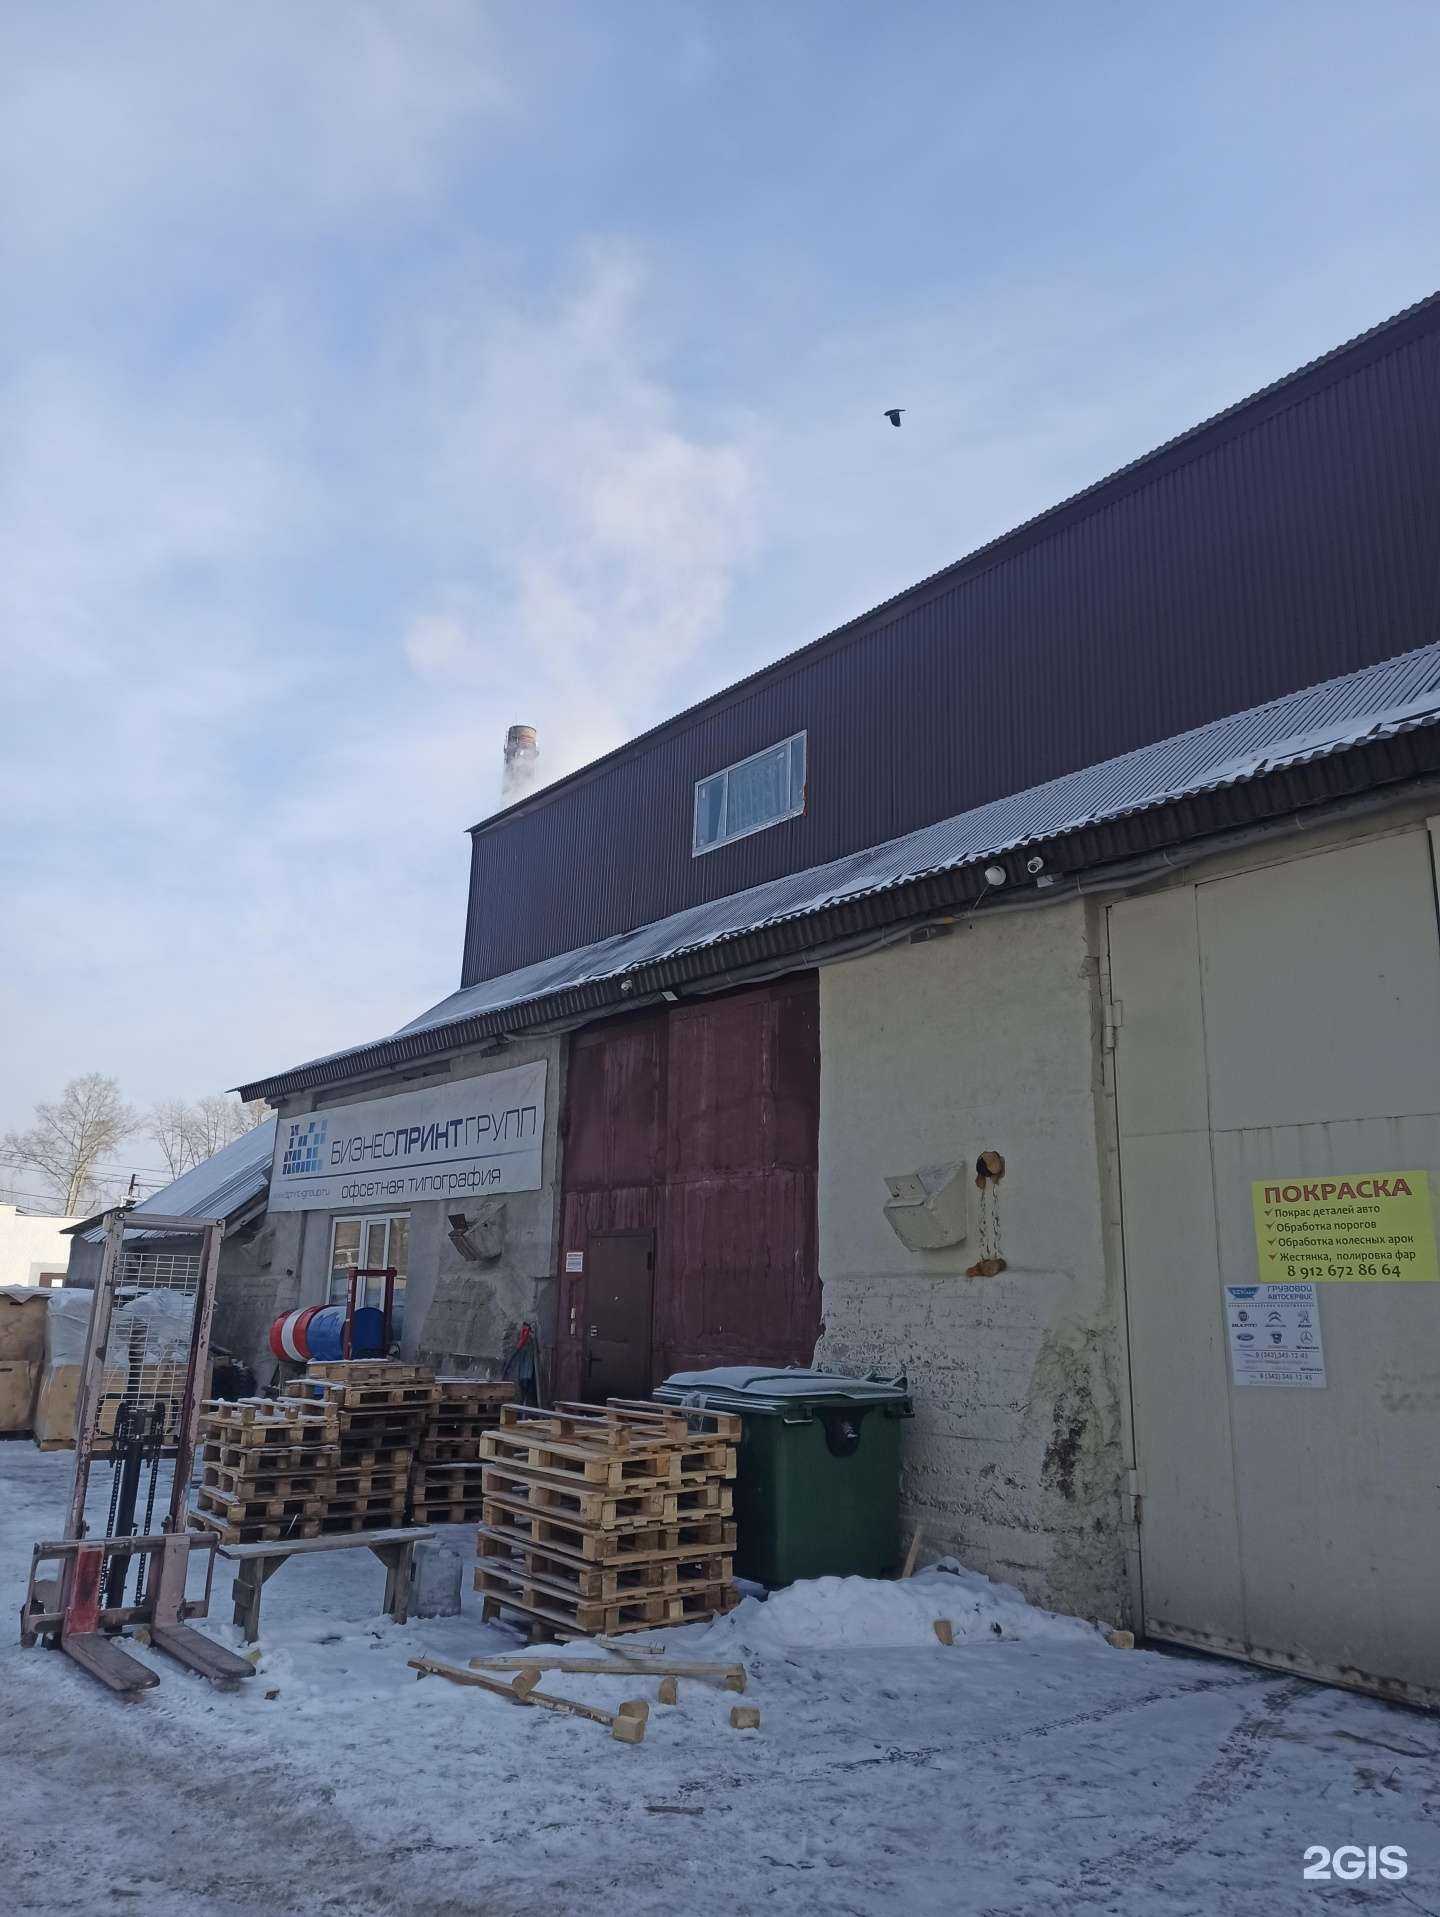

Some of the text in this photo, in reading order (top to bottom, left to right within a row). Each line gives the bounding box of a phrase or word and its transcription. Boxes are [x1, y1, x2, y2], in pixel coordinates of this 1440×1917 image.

[330, 1105, 537, 1165] БИЗНЕСПРИНТГРУПП
[341, 1165, 501, 1203] офсетная типография
[1264, 1178, 1413, 1204] ПОКРАСКА
[1275, 1204, 1381, 1219] Покрас деталей авто
[1276, 1221, 1377, 1234] Обработка порогов
[1278, 1234, 1414, 1249] Обработка колесных арок
[1280, 1249, 1416, 1263] Жестянка, полировка фар
[1287, 1264, 1401, 1279] 8 912 672 86 64
